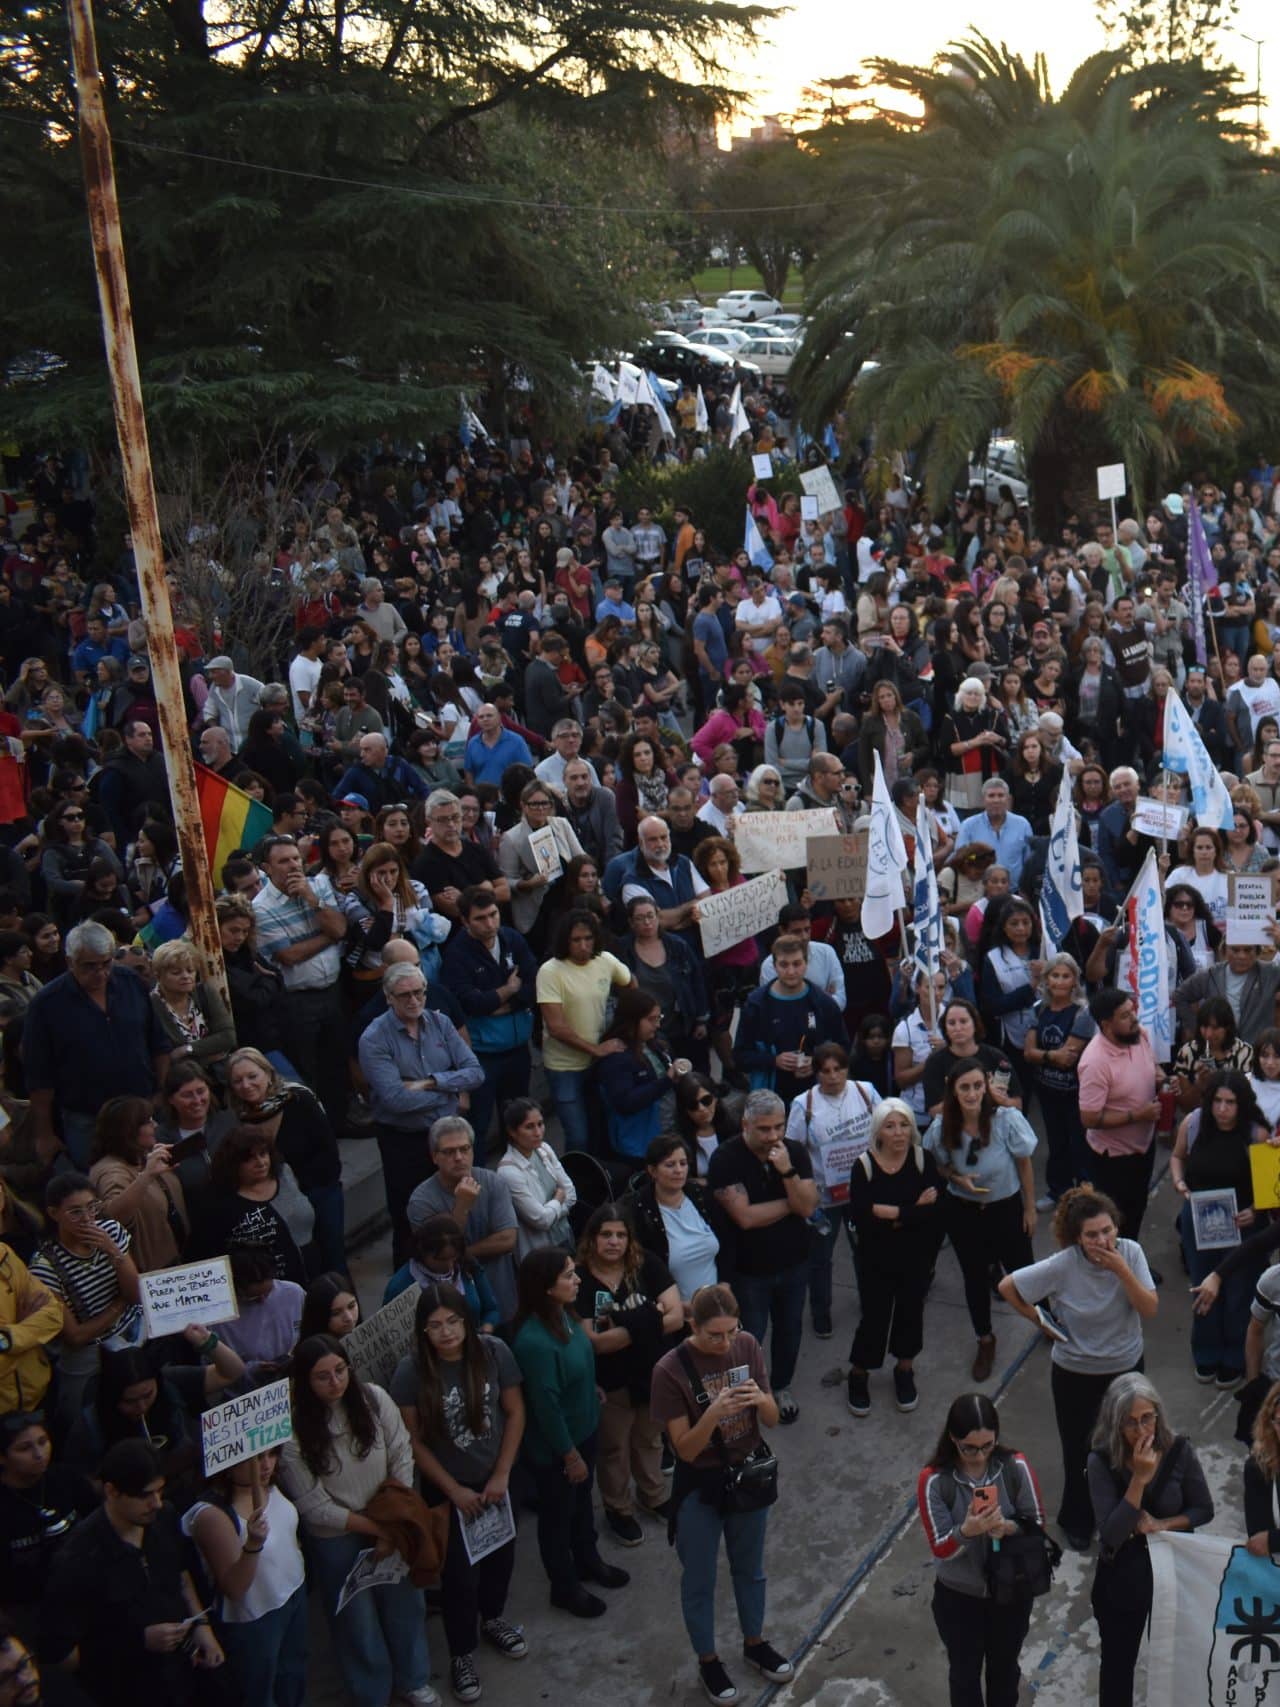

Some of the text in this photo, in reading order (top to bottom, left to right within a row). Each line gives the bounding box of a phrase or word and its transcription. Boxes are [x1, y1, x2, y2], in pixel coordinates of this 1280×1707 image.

[186, 1274, 228, 1291] TENEMOS
[175, 1294, 211, 1307] MATAR
[203, 1411, 221, 1432] NO
[223, 1394, 261, 1422] FALTAN
[203, 1425, 230, 1450] NES
[203, 1438, 244, 1469] FALTAN
